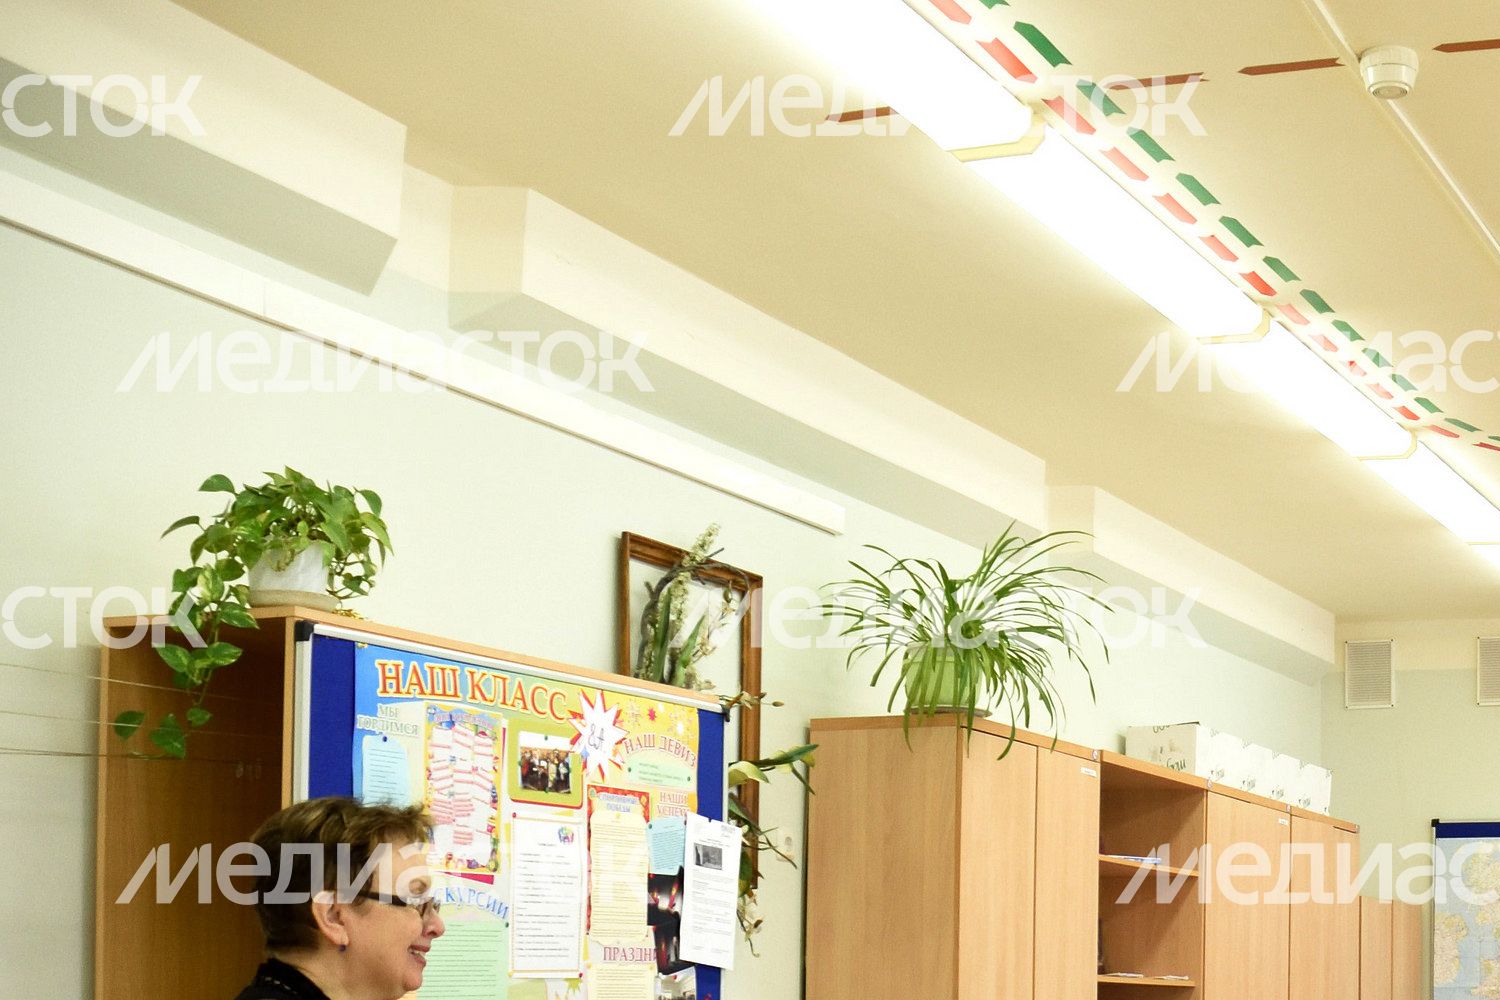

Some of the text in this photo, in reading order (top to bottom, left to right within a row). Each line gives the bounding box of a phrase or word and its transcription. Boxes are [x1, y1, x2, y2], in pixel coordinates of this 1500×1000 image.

[377, 661, 461, 699] НАШ
[467, 669, 567, 721] КЛАСС
[358, 715, 419, 736] ГОРДИМСЯ
[378, 704, 401, 719] МЫ
[623, 733, 697, 768] НАШ ДЕВИЗ
[433, 886, 510, 920] СКУРСИИ
